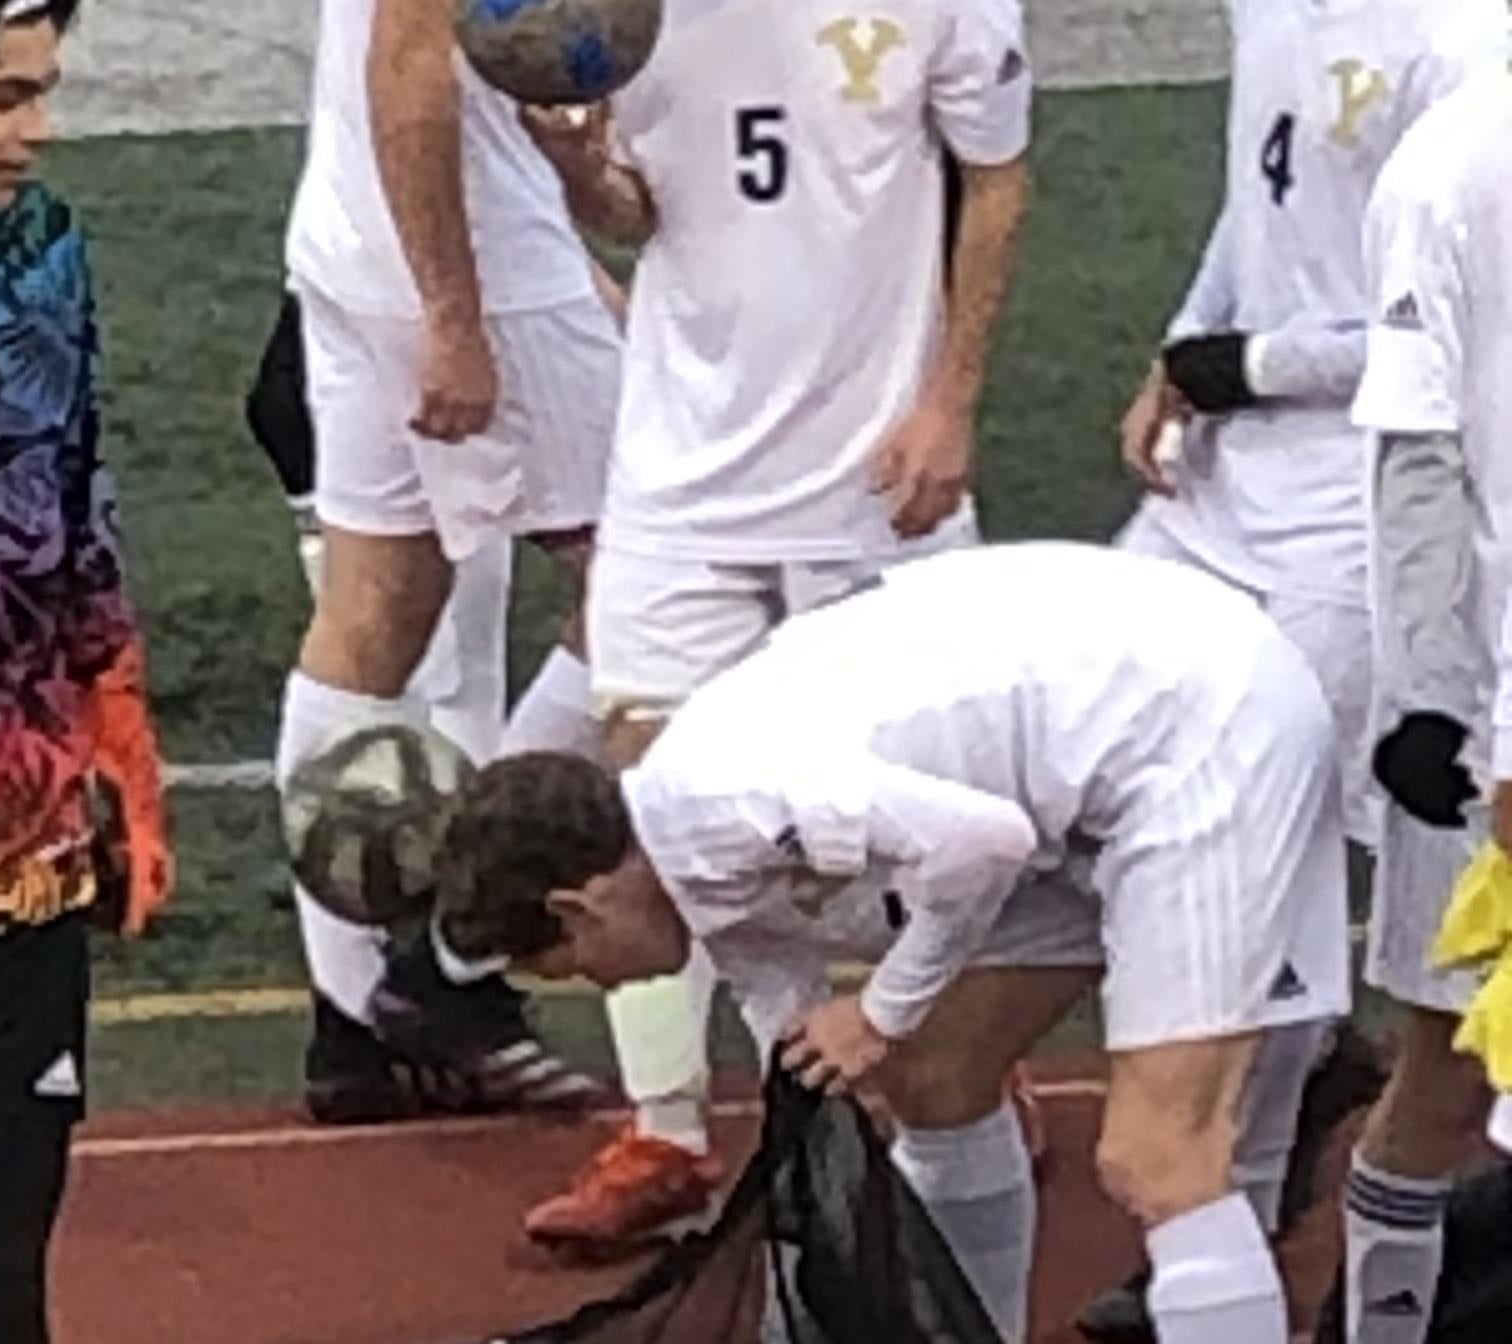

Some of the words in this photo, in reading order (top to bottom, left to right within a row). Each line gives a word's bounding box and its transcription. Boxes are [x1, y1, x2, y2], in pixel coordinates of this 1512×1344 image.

[816, 18, 906, 102] Y
[736, 108, 788, 203] 5
[1262, 112, 1294, 206] 4
